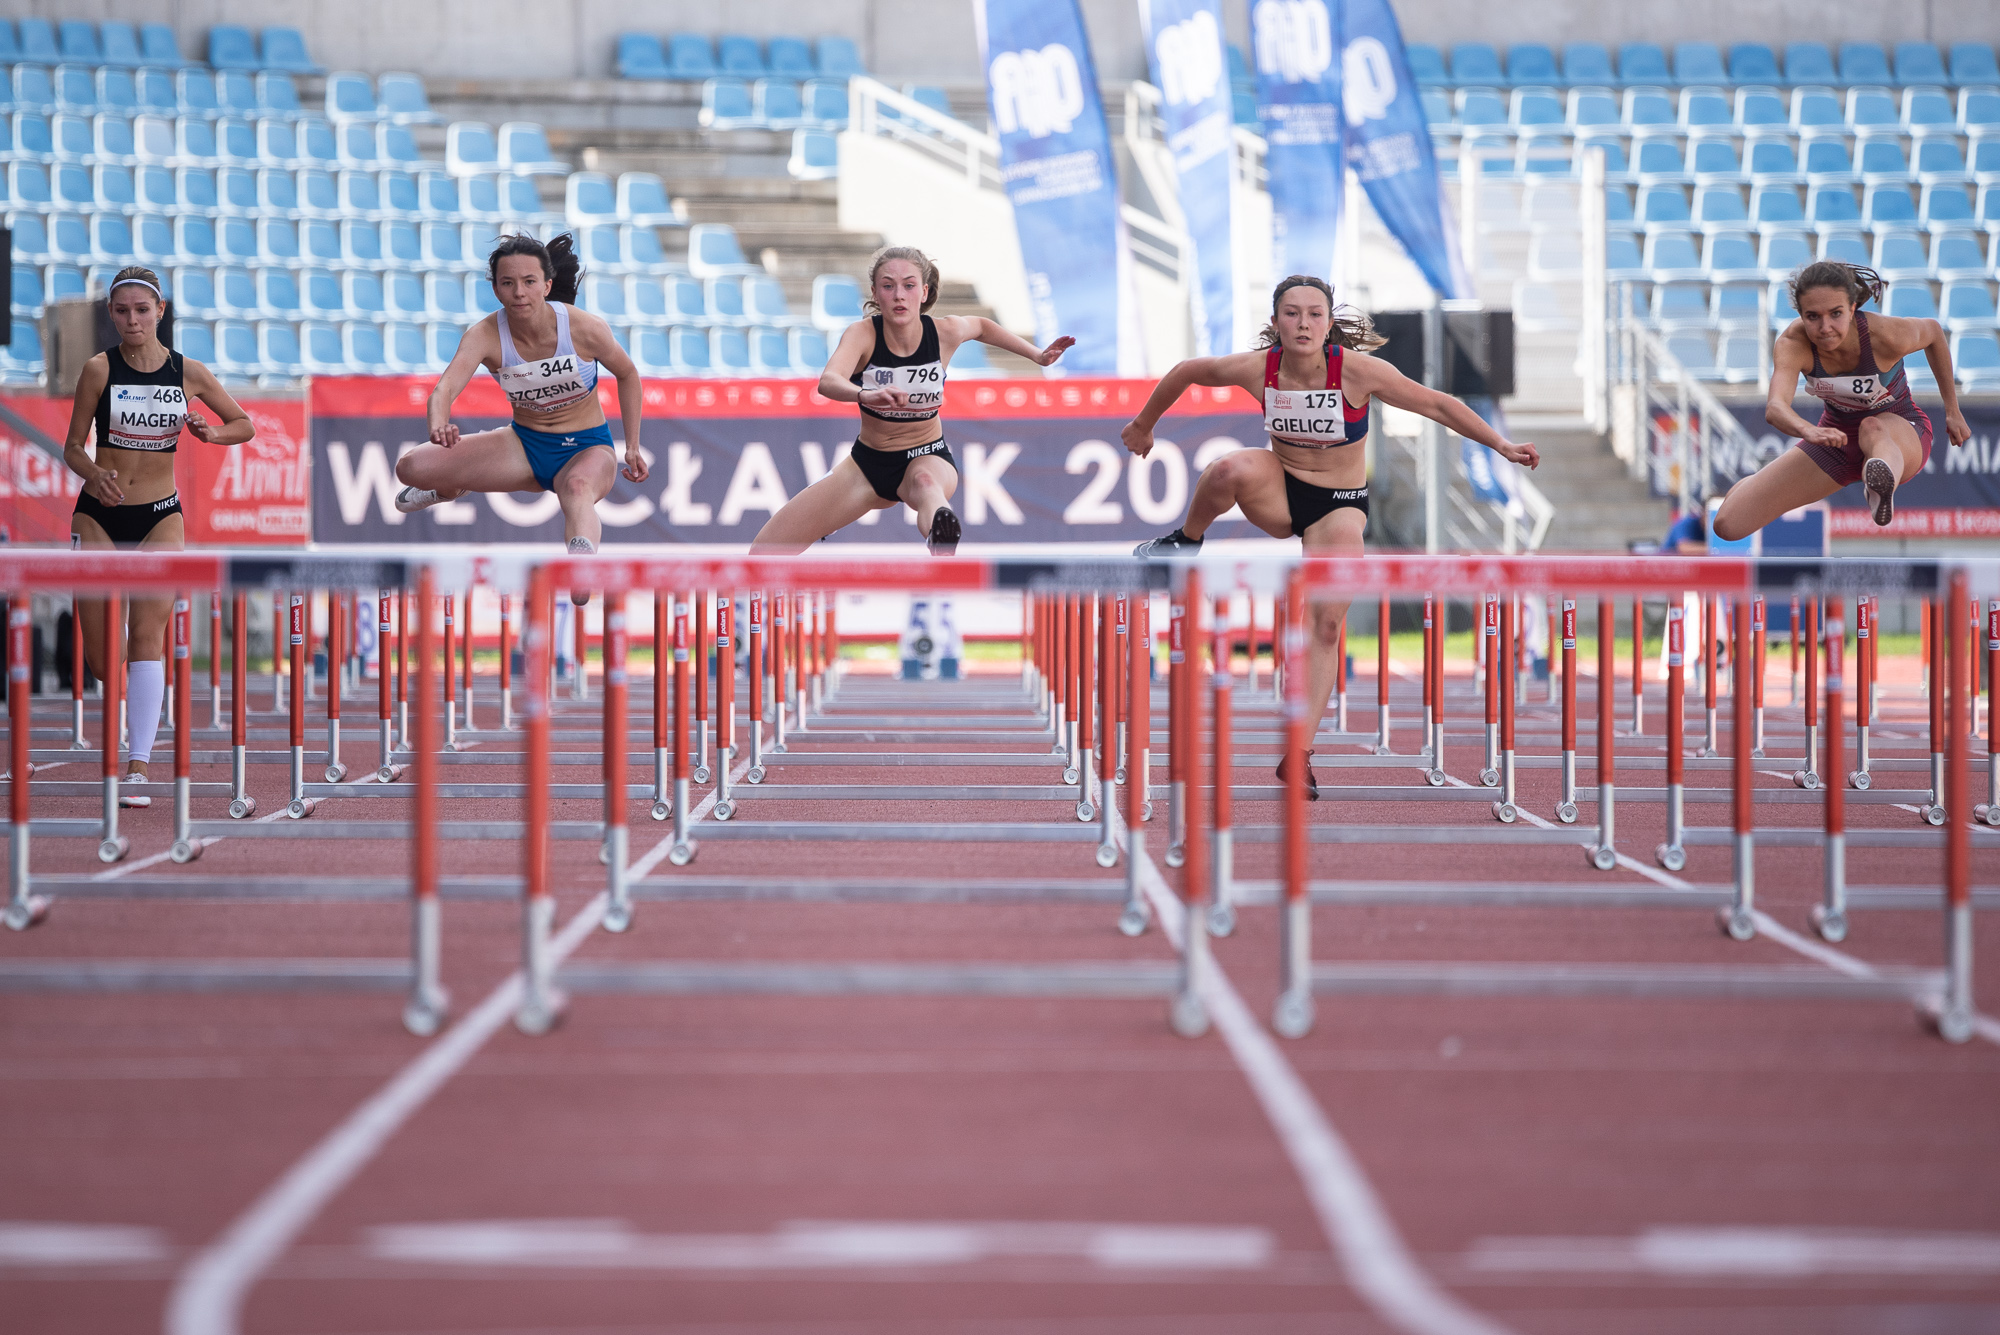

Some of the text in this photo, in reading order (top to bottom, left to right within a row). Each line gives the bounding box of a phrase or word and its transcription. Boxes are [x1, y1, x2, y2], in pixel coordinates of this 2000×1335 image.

[540, 358, 573, 378] 344
[907, 367, 939, 383] 796
[509, 381, 582, 401] SZCZĘSNA
[1852, 378, 1874, 394] 82
[153, 389, 182, 403] 468
[907, 391, 940, 404] CZYK
[975, 386, 1130, 407] POLSKI
[1305, 393, 1337, 408] 175
[120, 411, 178, 428] MAGER
[1272, 418, 1335, 433] GIELICZ
[112, 436, 163, 449] WŁOCŁAWEK
[907, 440, 945, 459] NIKE PRO
[1333, 490, 1356, 500] NIKE
[153, 498, 175, 512] NIKE
